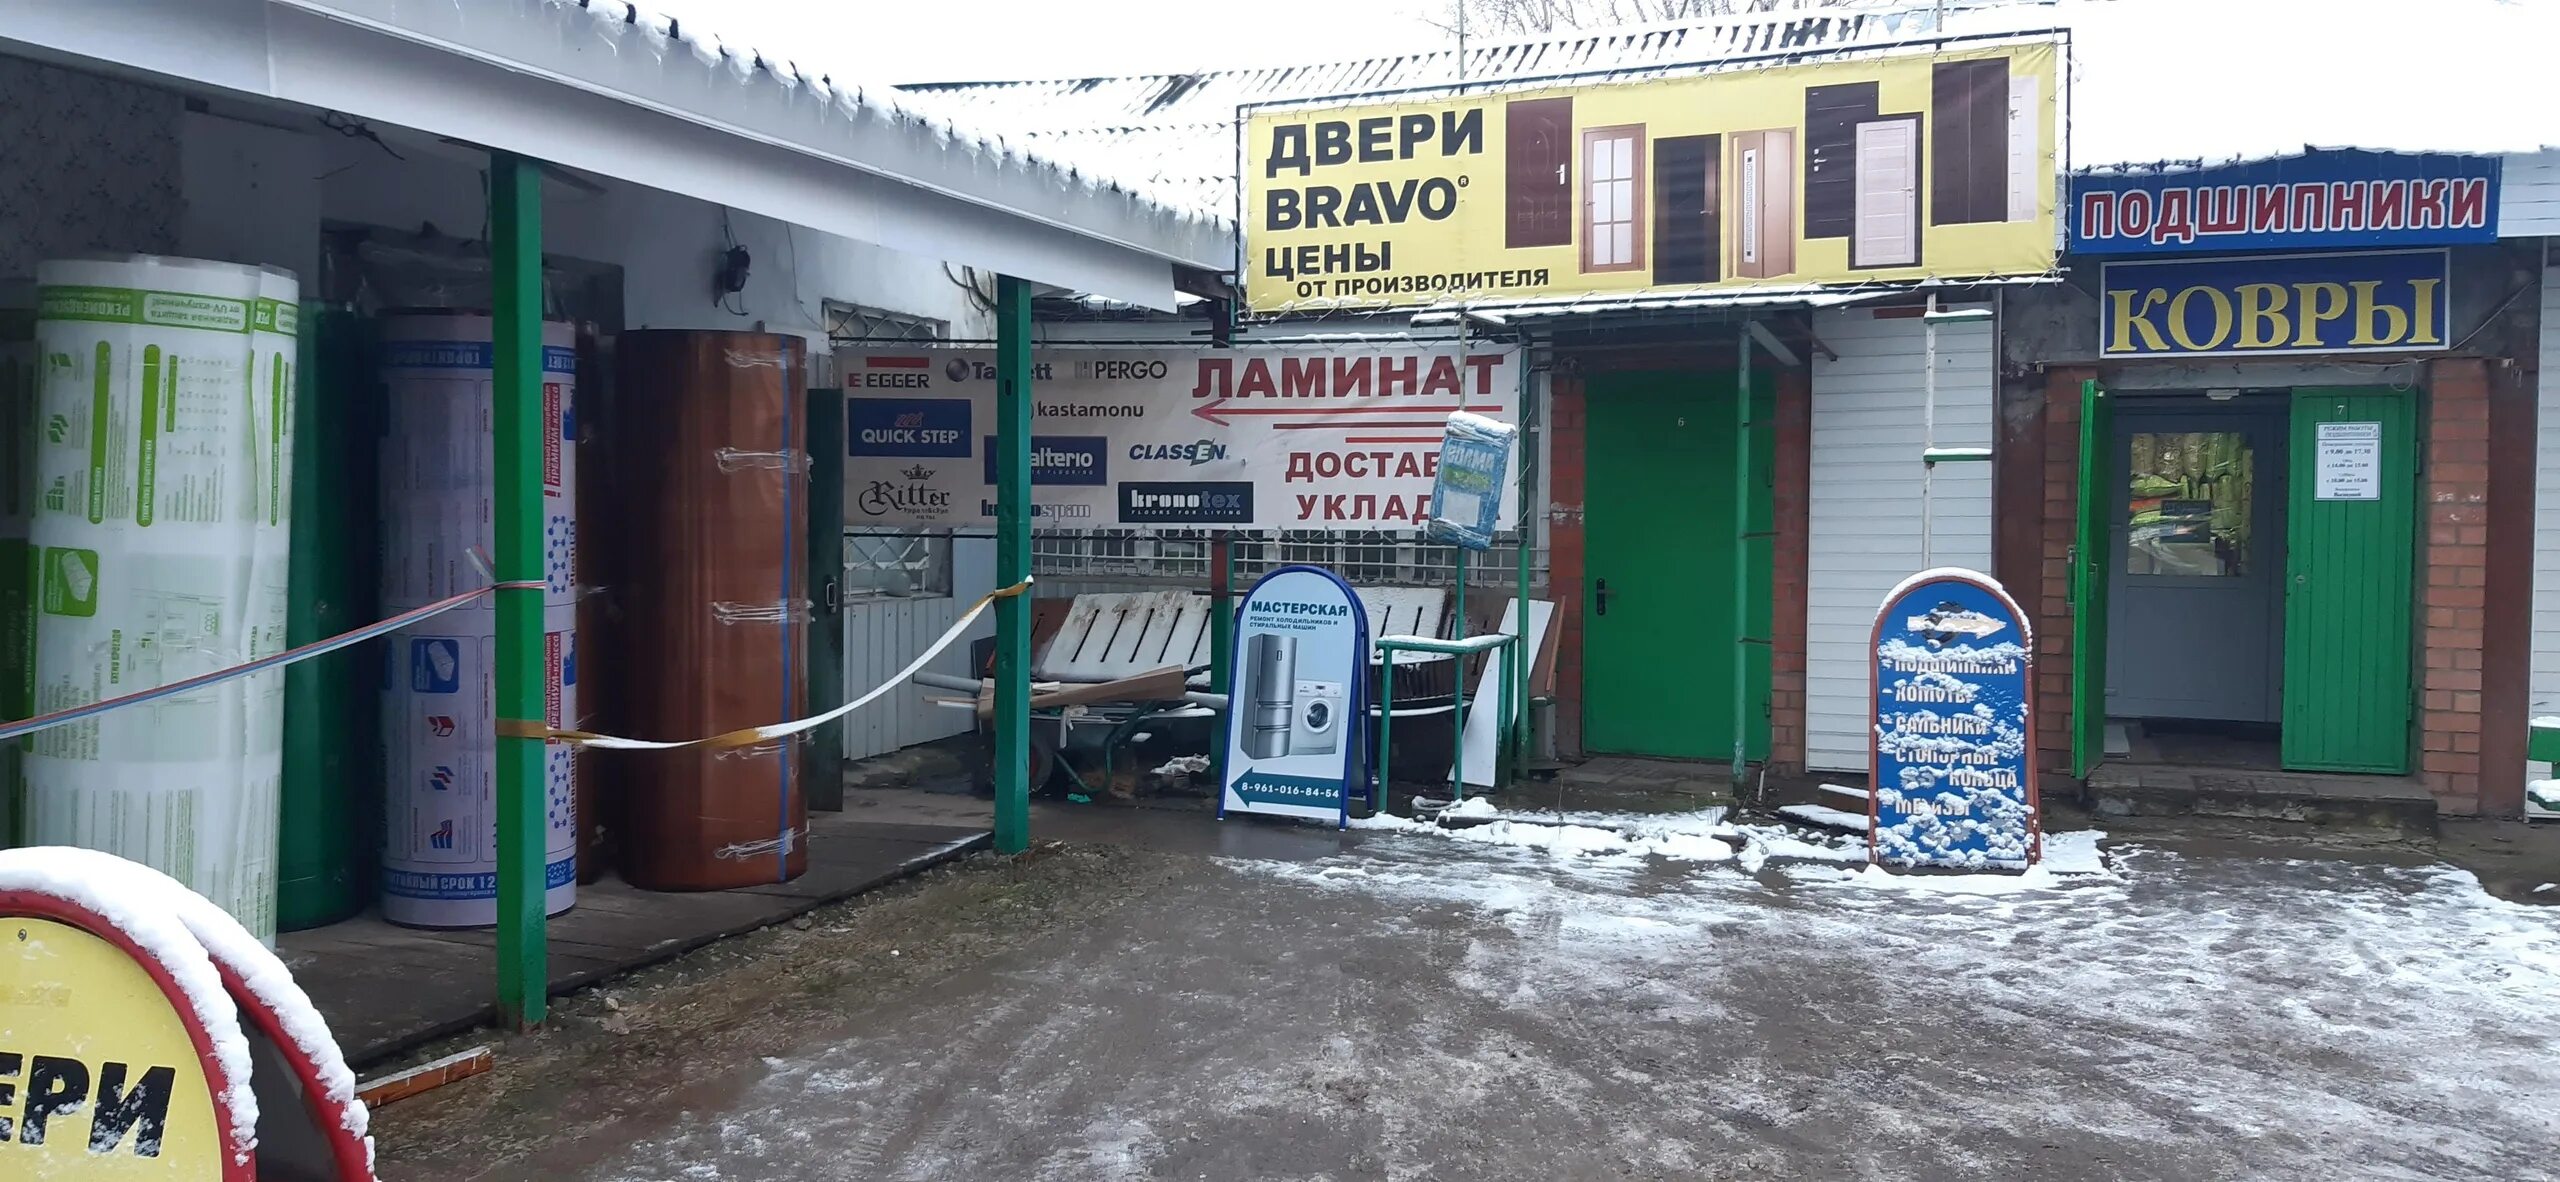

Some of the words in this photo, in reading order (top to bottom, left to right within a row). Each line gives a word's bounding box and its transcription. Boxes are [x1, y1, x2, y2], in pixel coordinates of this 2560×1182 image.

[1266, 108, 1482, 178] ДВЕРИ
[1266, 177, 1457, 231] BRAVO
[2081, 178, 2488, 245] ПОДШИПНИКИ
[1266, 241, 1391, 282] ЦЕНЫ
[1297, 281, 1327, 298] ОТ
[1335, 269, 1549, 296] ПРОИЗВОДИТЕЛЯ
[2106, 278, 2442, 353] КОВРЫ
[972, 361, 1053, 380] Tatt
[1095, 361, 1167, 379] PERGO
[1192, 354, 1504, 398] ЛАМИНАТ
[867, 373, 930, 388] EGGER
[1038, 401, 1144, 417] kastamonu
[2337, 405, 2344, 415] 7
[1677, 417, 1685, 427] 6
[861, 429, 916, 444] QUICK
[921, 429, 959, 444] STEP
[1030, 447, 1093, 468] alterio
[1129, 443, 1227, 461] CLASSEN
[1285, 451, 1442, 483] ДОСТАВ
[859, 481, 951, 515] Ritter
[1131, 490, 1241, 508] kronotex
[1296, 494, 1434, 525] УКЛАД
[1251, 601, 1347, 616] МАСТЕРСКАЯ
[1276, 617, 1332, 625] ХОЛОДИЛЬНИКОВ
[1896, 715, 1989, 735] САЛЬНИКИ
[1241, 782, 1340, 798] 8-961-016-84-54
[1895, 798, 1970, 816] МЕИЗЫ
[440, 877, 475, 889] СРОК
